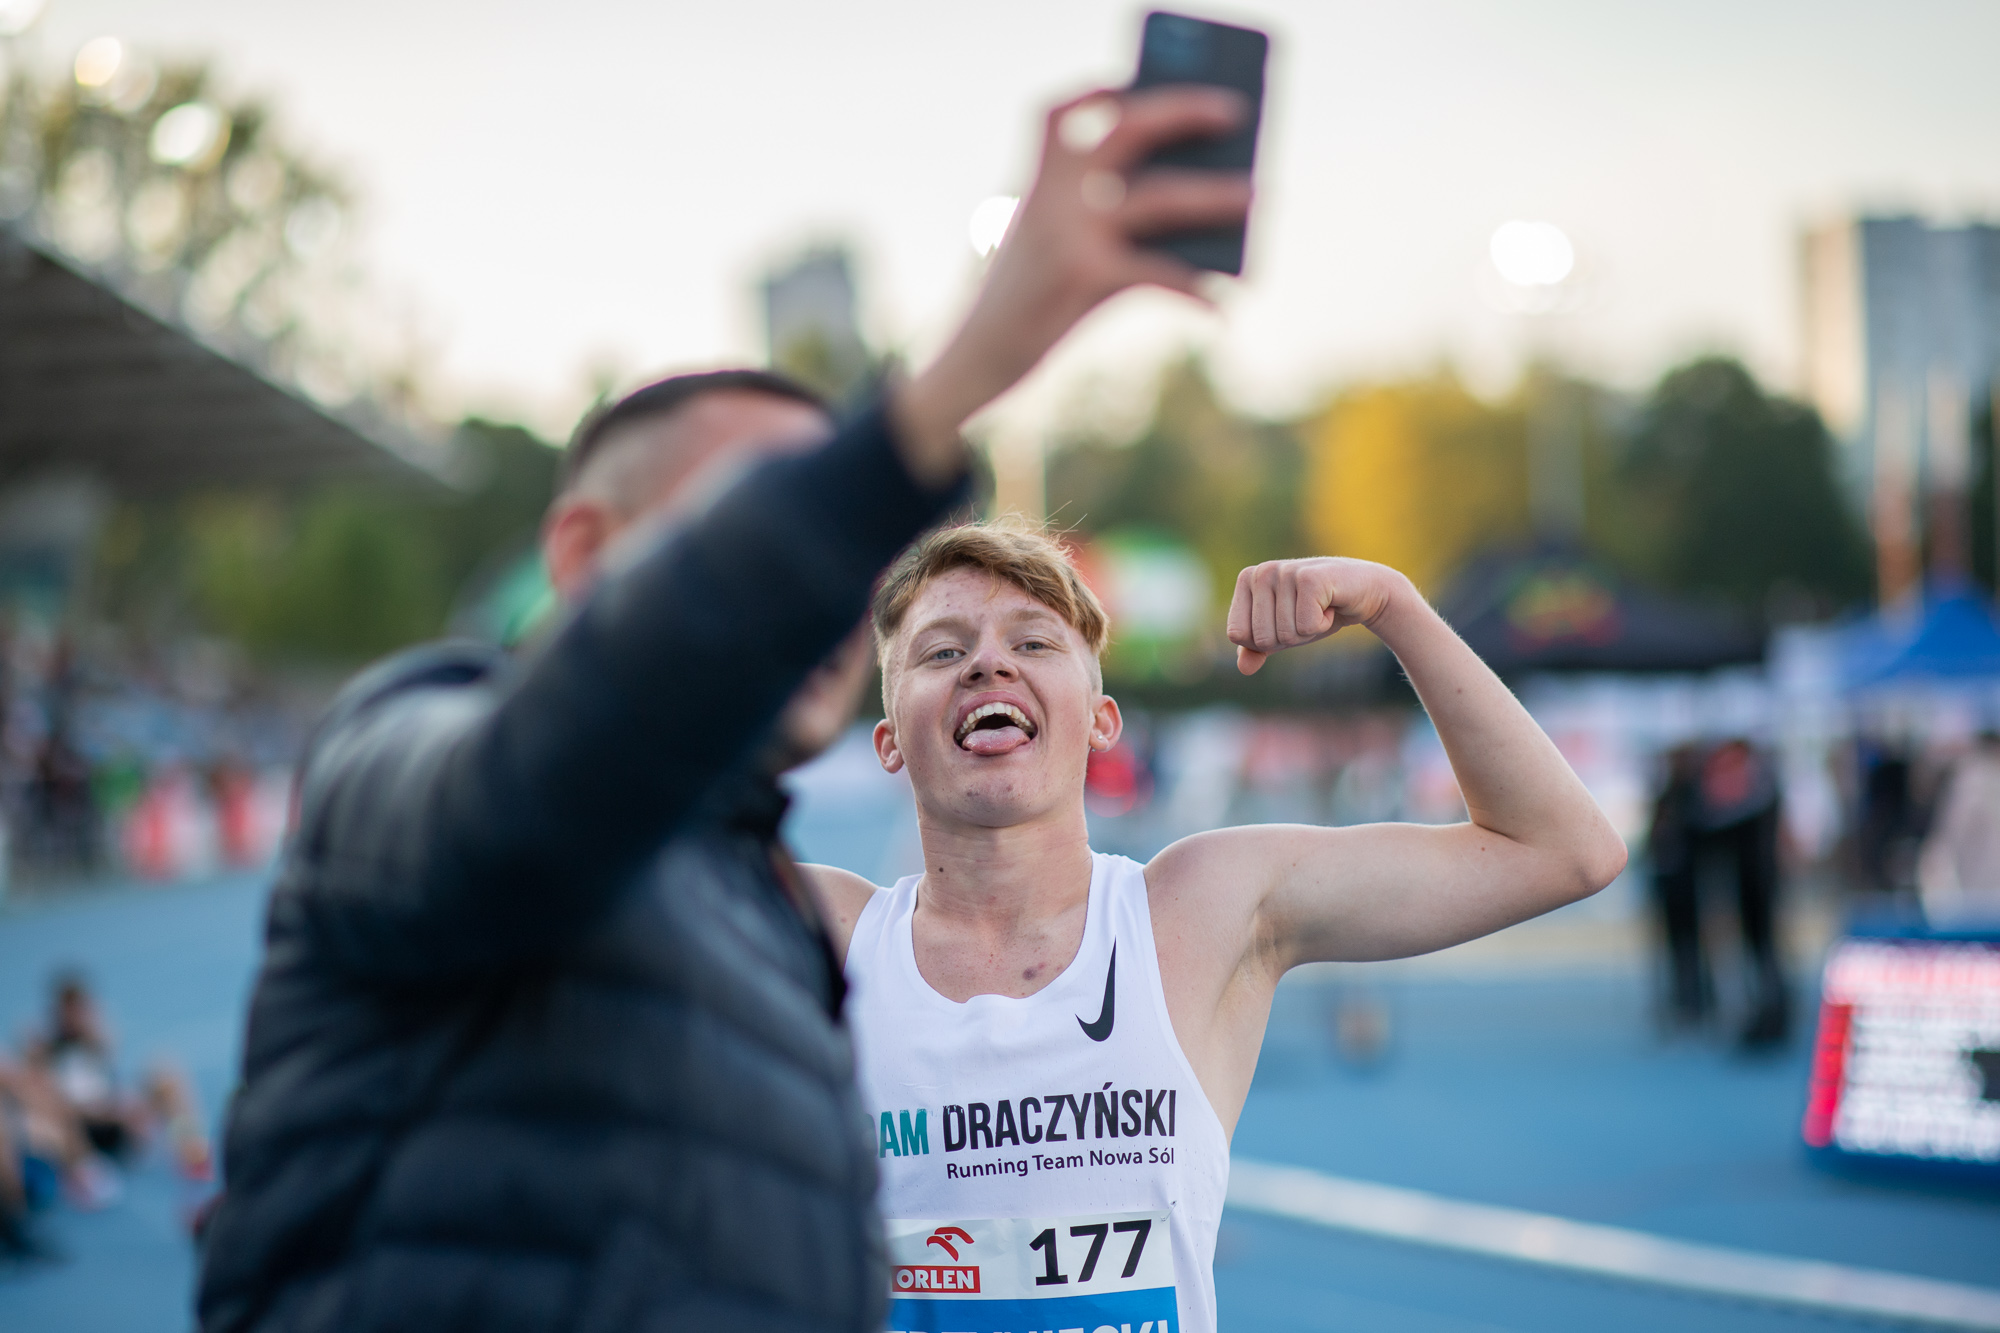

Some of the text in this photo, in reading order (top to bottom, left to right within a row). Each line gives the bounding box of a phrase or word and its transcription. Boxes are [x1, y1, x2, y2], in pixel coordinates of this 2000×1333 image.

[942, 1081, 1177, 1153] DRACZYŃSKI
[946, 1147, 1175, 1180] Running Team Nowa Sól
[1028, 1218, 1152, 1287] 177
[896, 1268, 975, 1290] ORLEN
